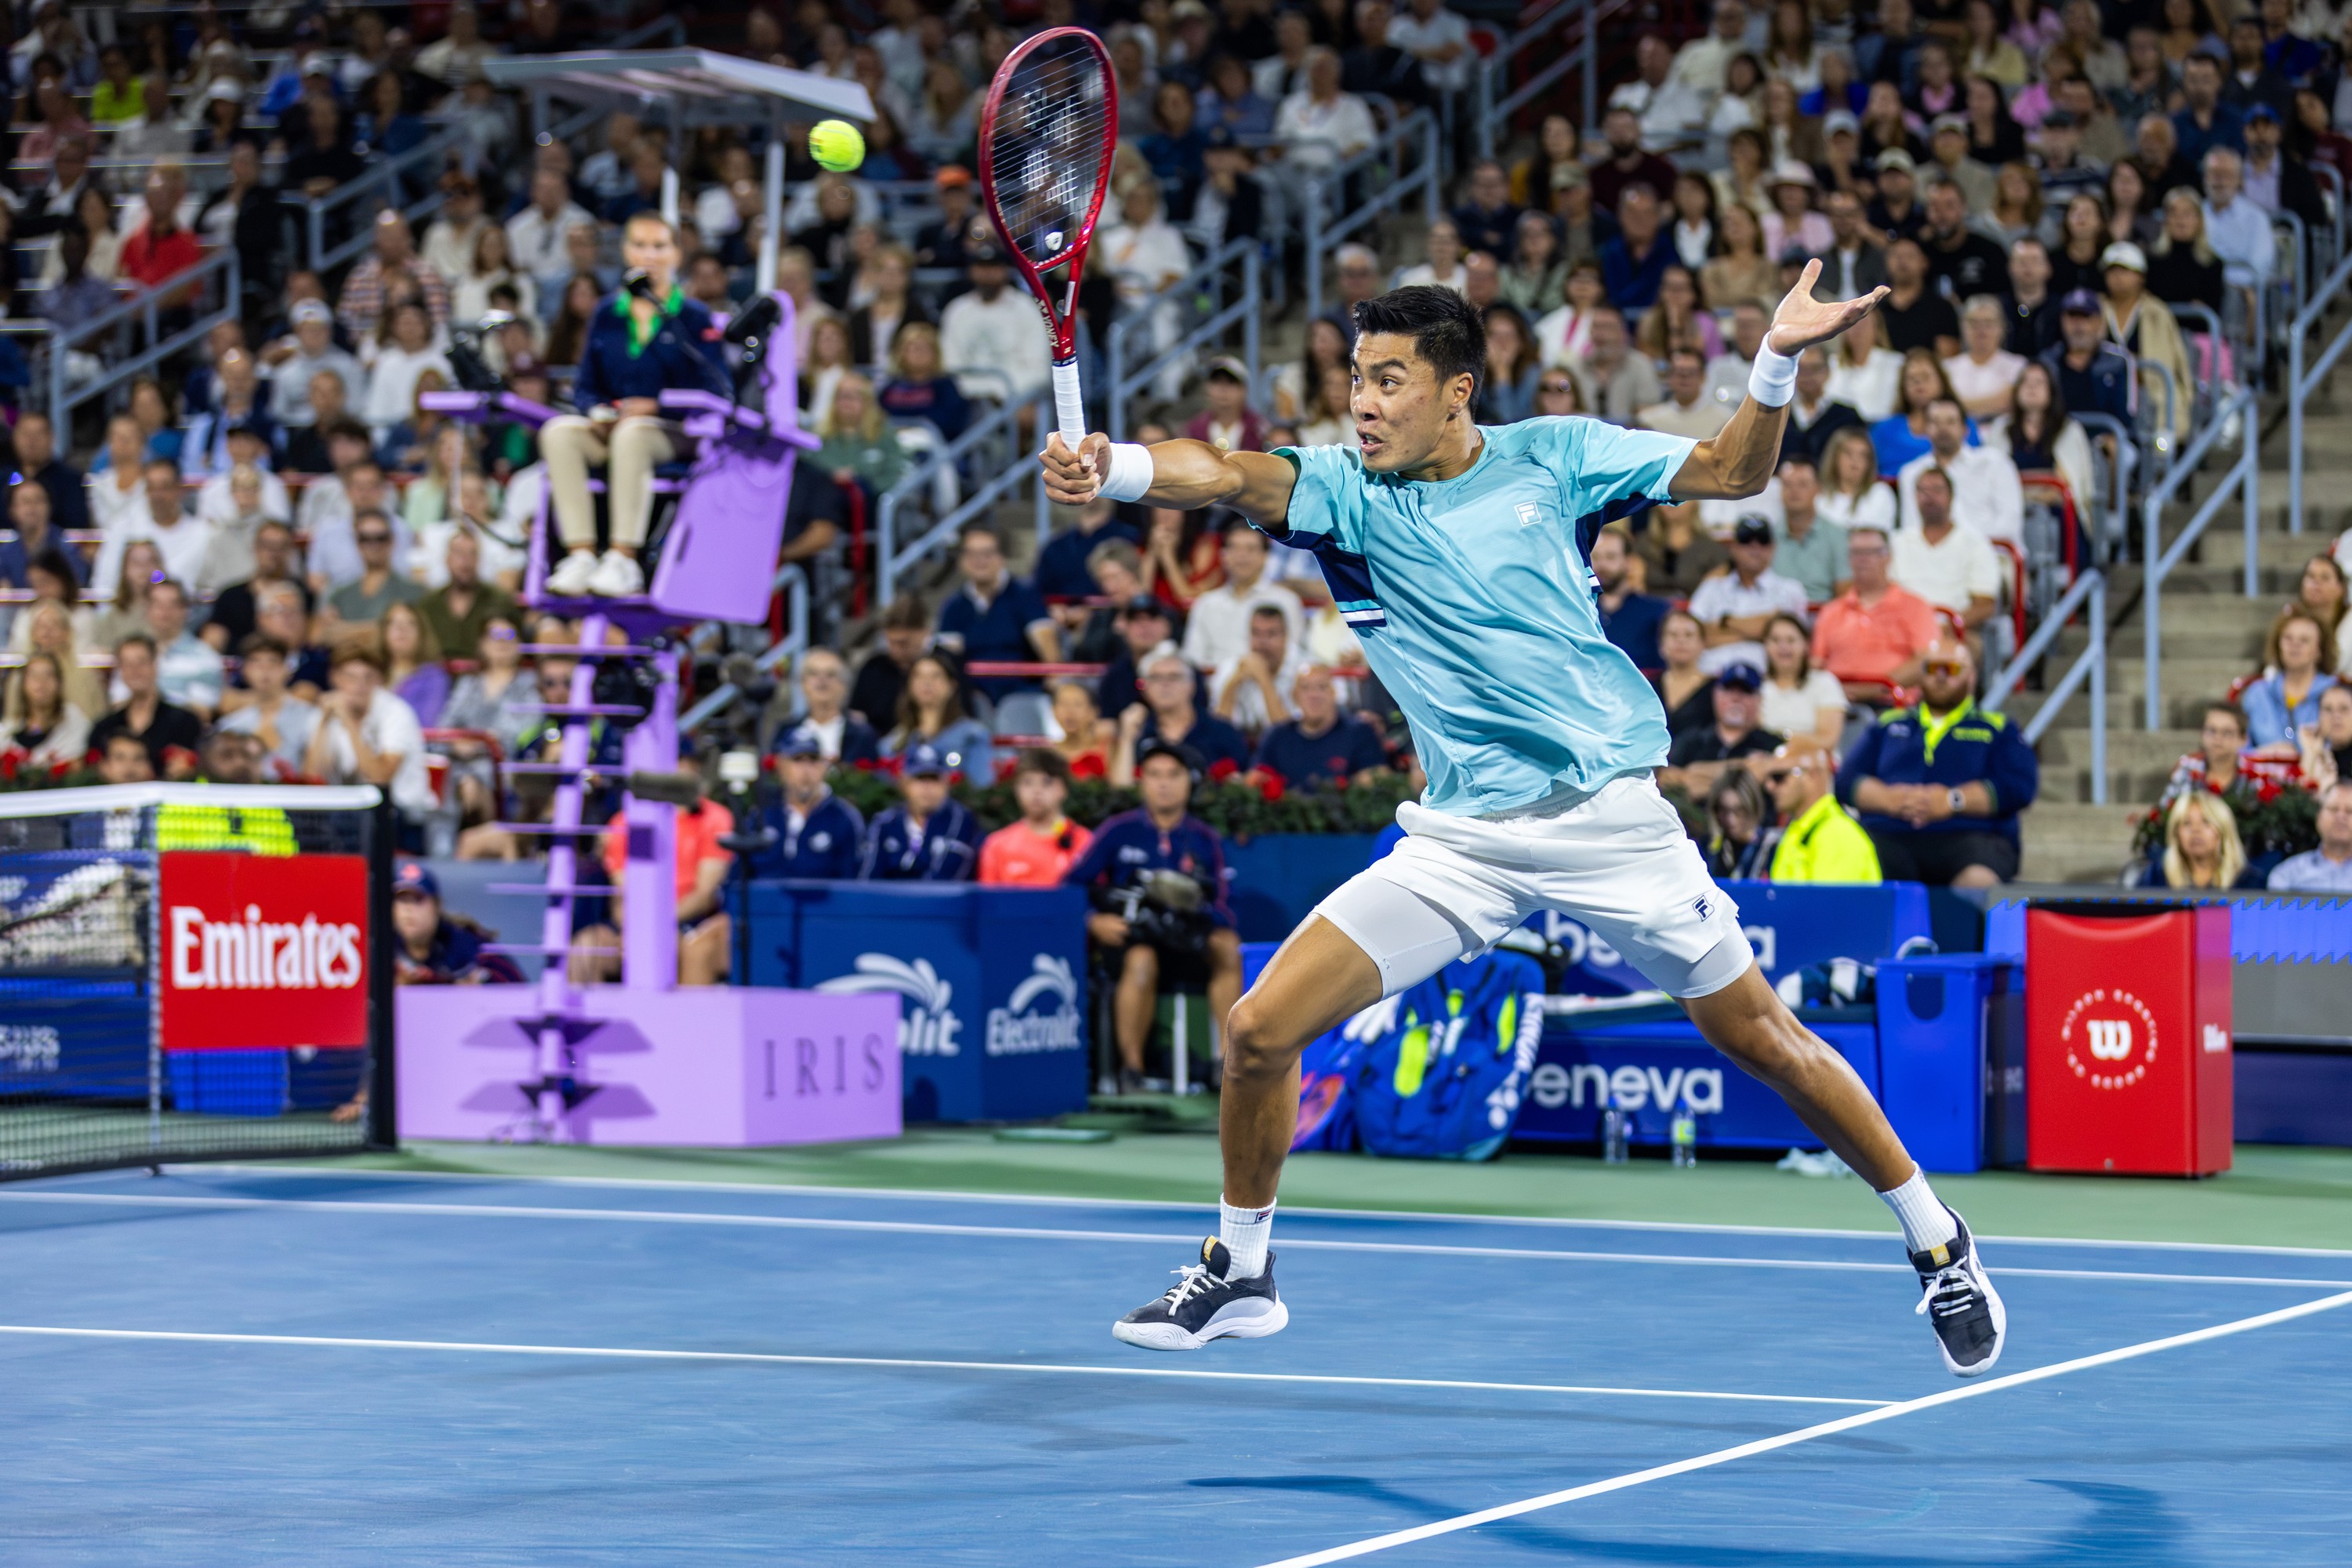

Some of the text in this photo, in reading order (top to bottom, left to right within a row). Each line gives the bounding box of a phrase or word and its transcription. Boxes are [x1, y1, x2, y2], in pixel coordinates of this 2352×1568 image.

[1043, 314, 1059, 347] YONEX
[170, 903, 362, 989] Emirates
[764, 1033, 885, 1102] IRIS
